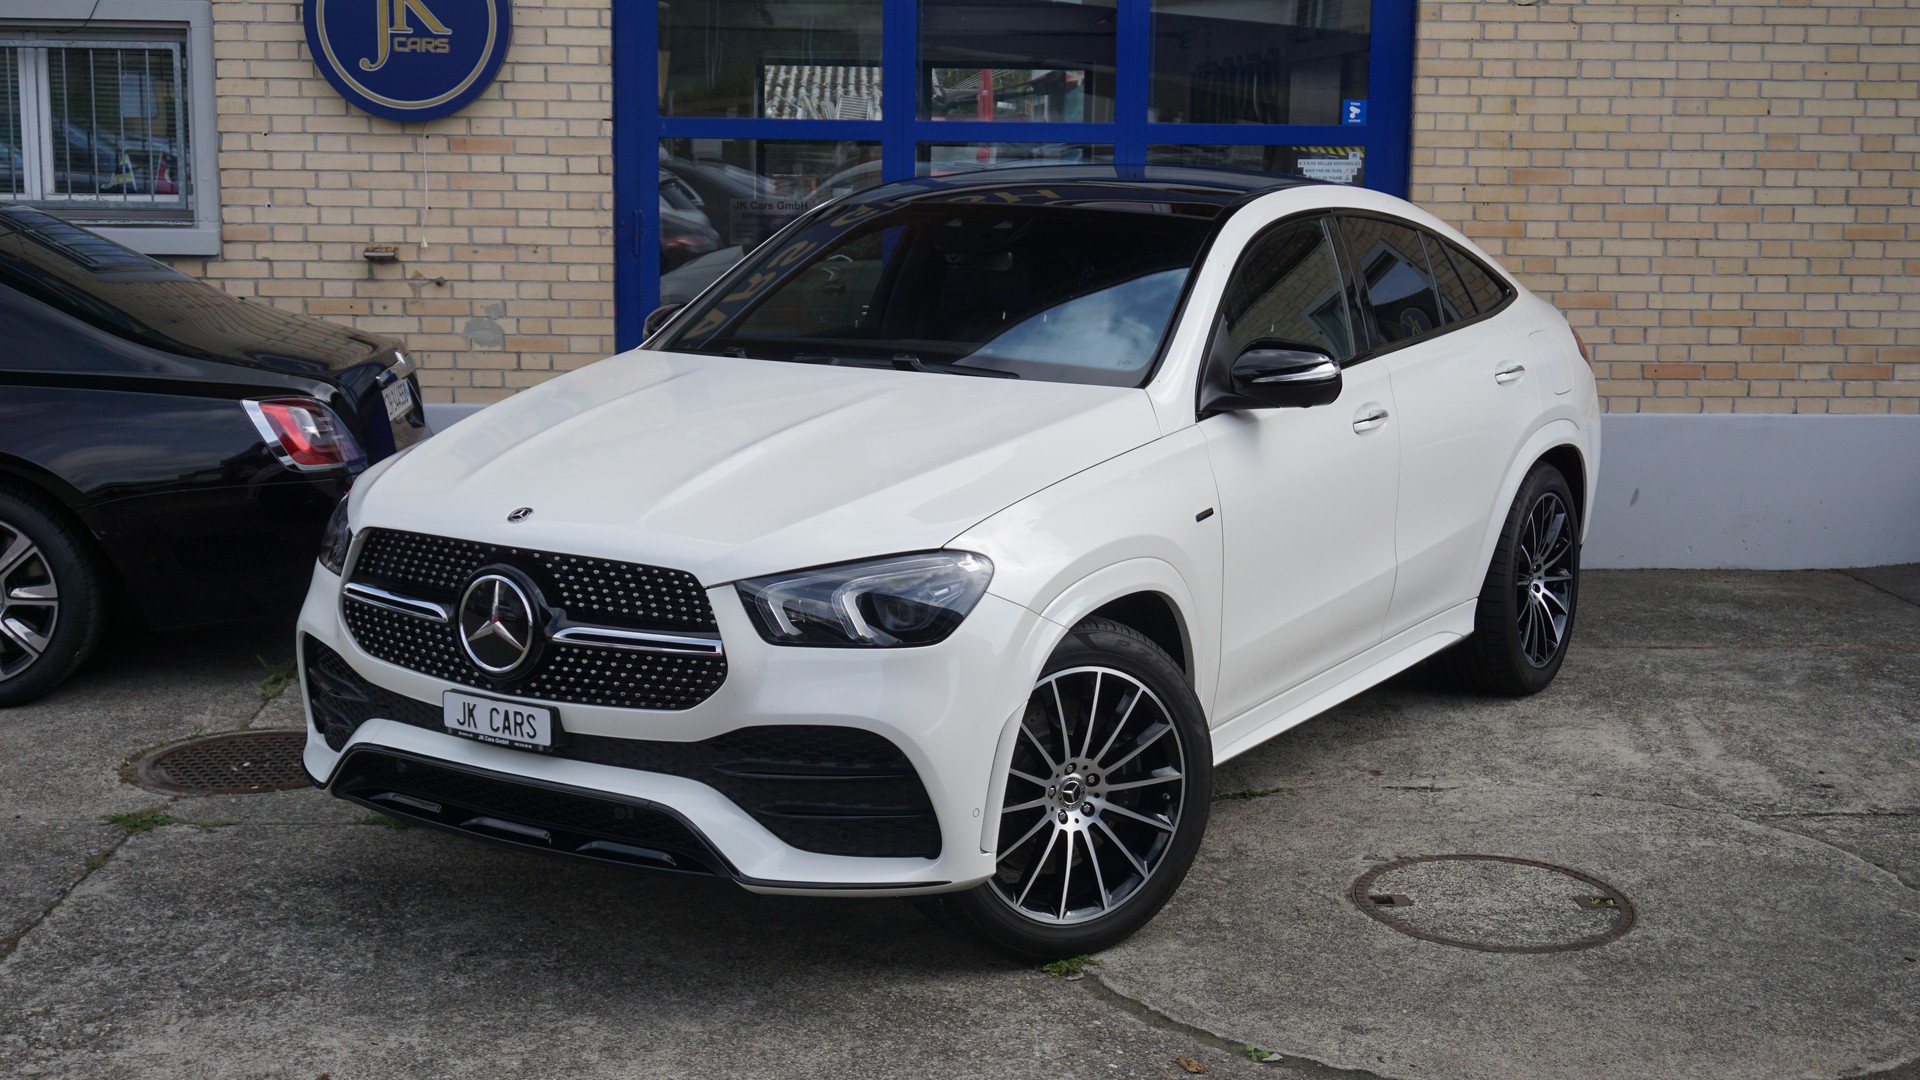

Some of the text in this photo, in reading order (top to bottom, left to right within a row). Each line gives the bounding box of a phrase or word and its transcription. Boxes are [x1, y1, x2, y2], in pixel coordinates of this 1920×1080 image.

[393, 36, 450, 53] CARS
[734, 201, 808, 210] JK Cars GmbH
[457, 701, 537, 739] JK CARS
